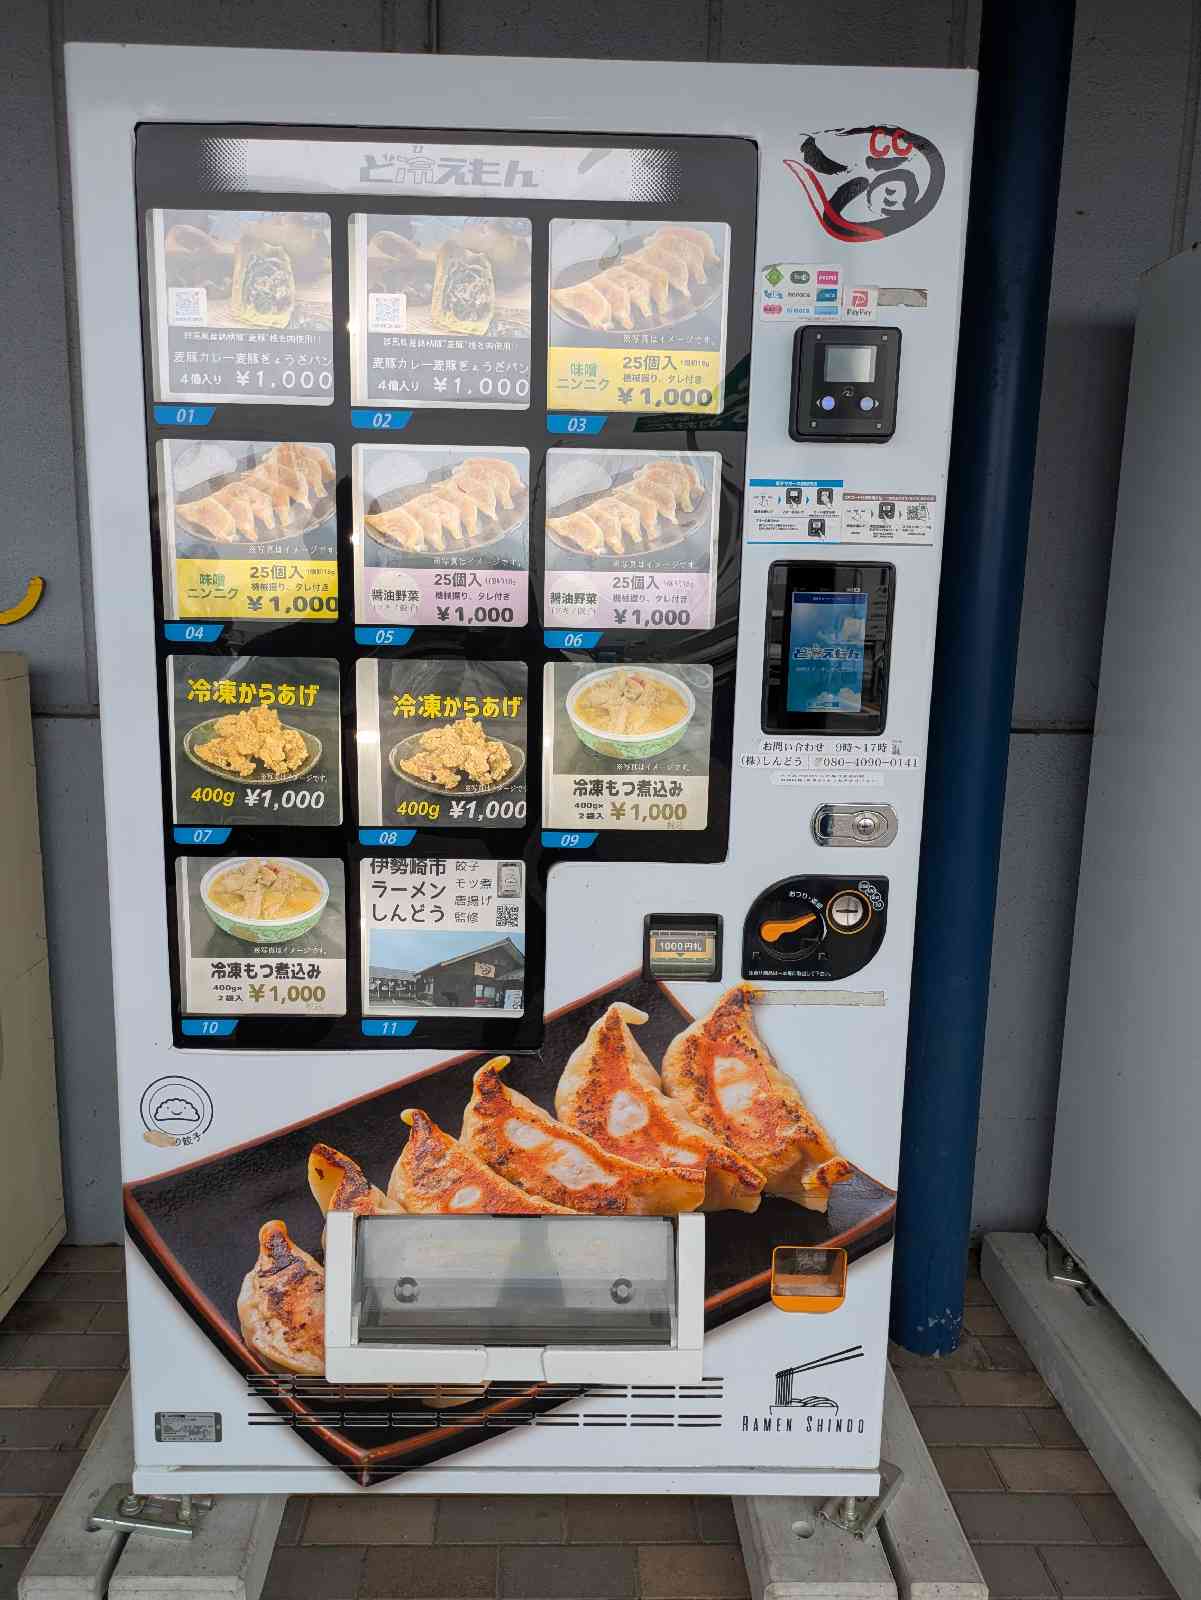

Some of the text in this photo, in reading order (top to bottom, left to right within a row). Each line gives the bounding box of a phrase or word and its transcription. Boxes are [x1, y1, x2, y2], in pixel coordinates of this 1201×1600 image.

[623, 354, 678, 371] 25個入
[556, 377, 609, 391] ニンニク
[176, 408, 195, 424] 01
[372, 412, 393, 428] 02
[567, 417, 587, 432] 03
[249, 564, 305, 580] 25個入
[433, 572, 482, 588] 25個入
[612, 575, 660, 591] 25個入
[186, 587, 240, 600] ニンニク
[436, 606, 515, 625] ¥1,000
[613, 608, 691, 627] ¥1,000
[185, 625, 204, 640] 04
[375, 629, 395, 645] 05
[564, 632, 584, 647] 06
[185, 677, 320, 706] 冷凍からあげ
[392, 692, 524, 719] 冷凍からあげ
[762, 741, 825, 753] お問い合わせ
[572, 778, 684, 798] 冷凍もつ煮込み
[190, 786, 236, 807] 400g
[396, 800, 441, 820] 400g
[193, 829, 213, 843] 07
[379, 831, 398, 845] 08
[560, 834, 580, 847] 09
[371, 880, 447, 900] ラーメン
[372, 895, 493, 923] しんどう 唐揚げ
[454, 911, 480, 924] 監修
[210, 961, 322, 980] 冷凍もつ煮込み
[201, 1022, 219, 1035] 10
[383, 1022, 398, 1035] 11
